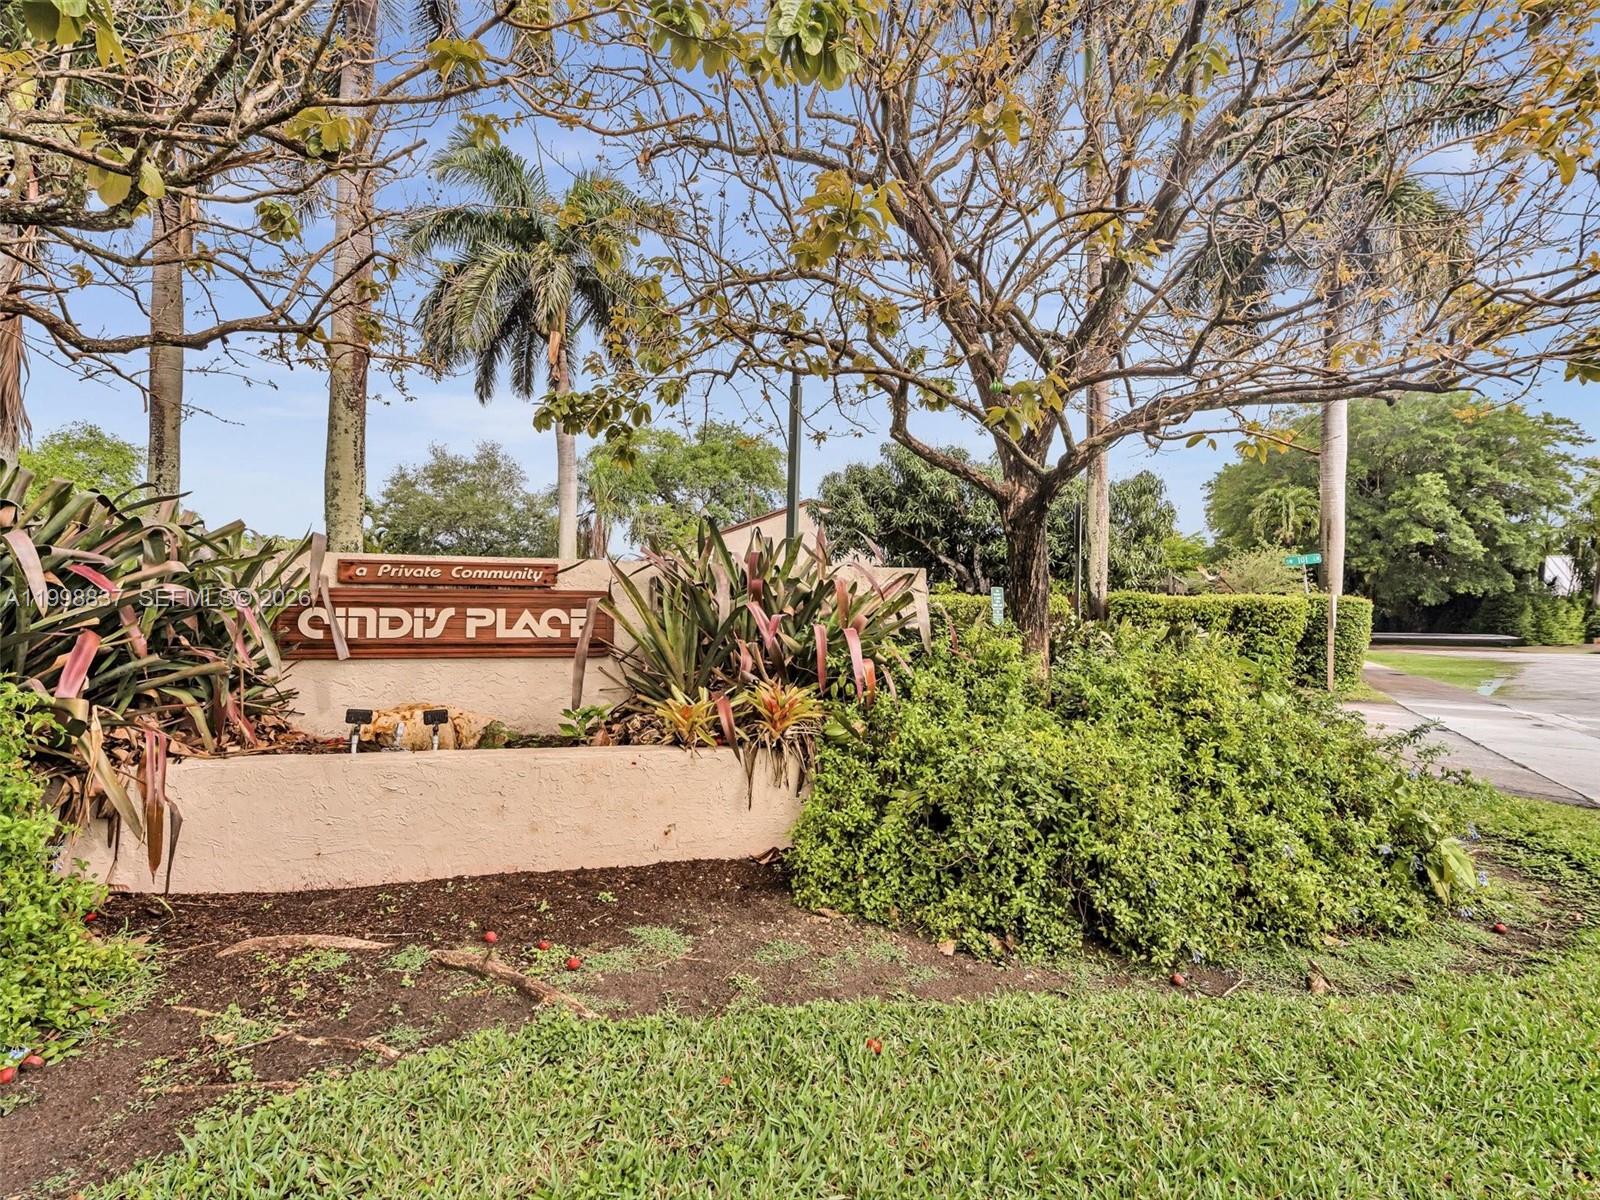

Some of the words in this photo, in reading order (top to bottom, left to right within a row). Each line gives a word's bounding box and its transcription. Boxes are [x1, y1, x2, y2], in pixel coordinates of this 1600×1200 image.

[1297, 555, 1309, 564] 101
[355, 567, 367, 577] a
[377, 564, 442, 578] Private
[451, 566, 543, 582] Community
[465, 607, 593, 638] PLACE
